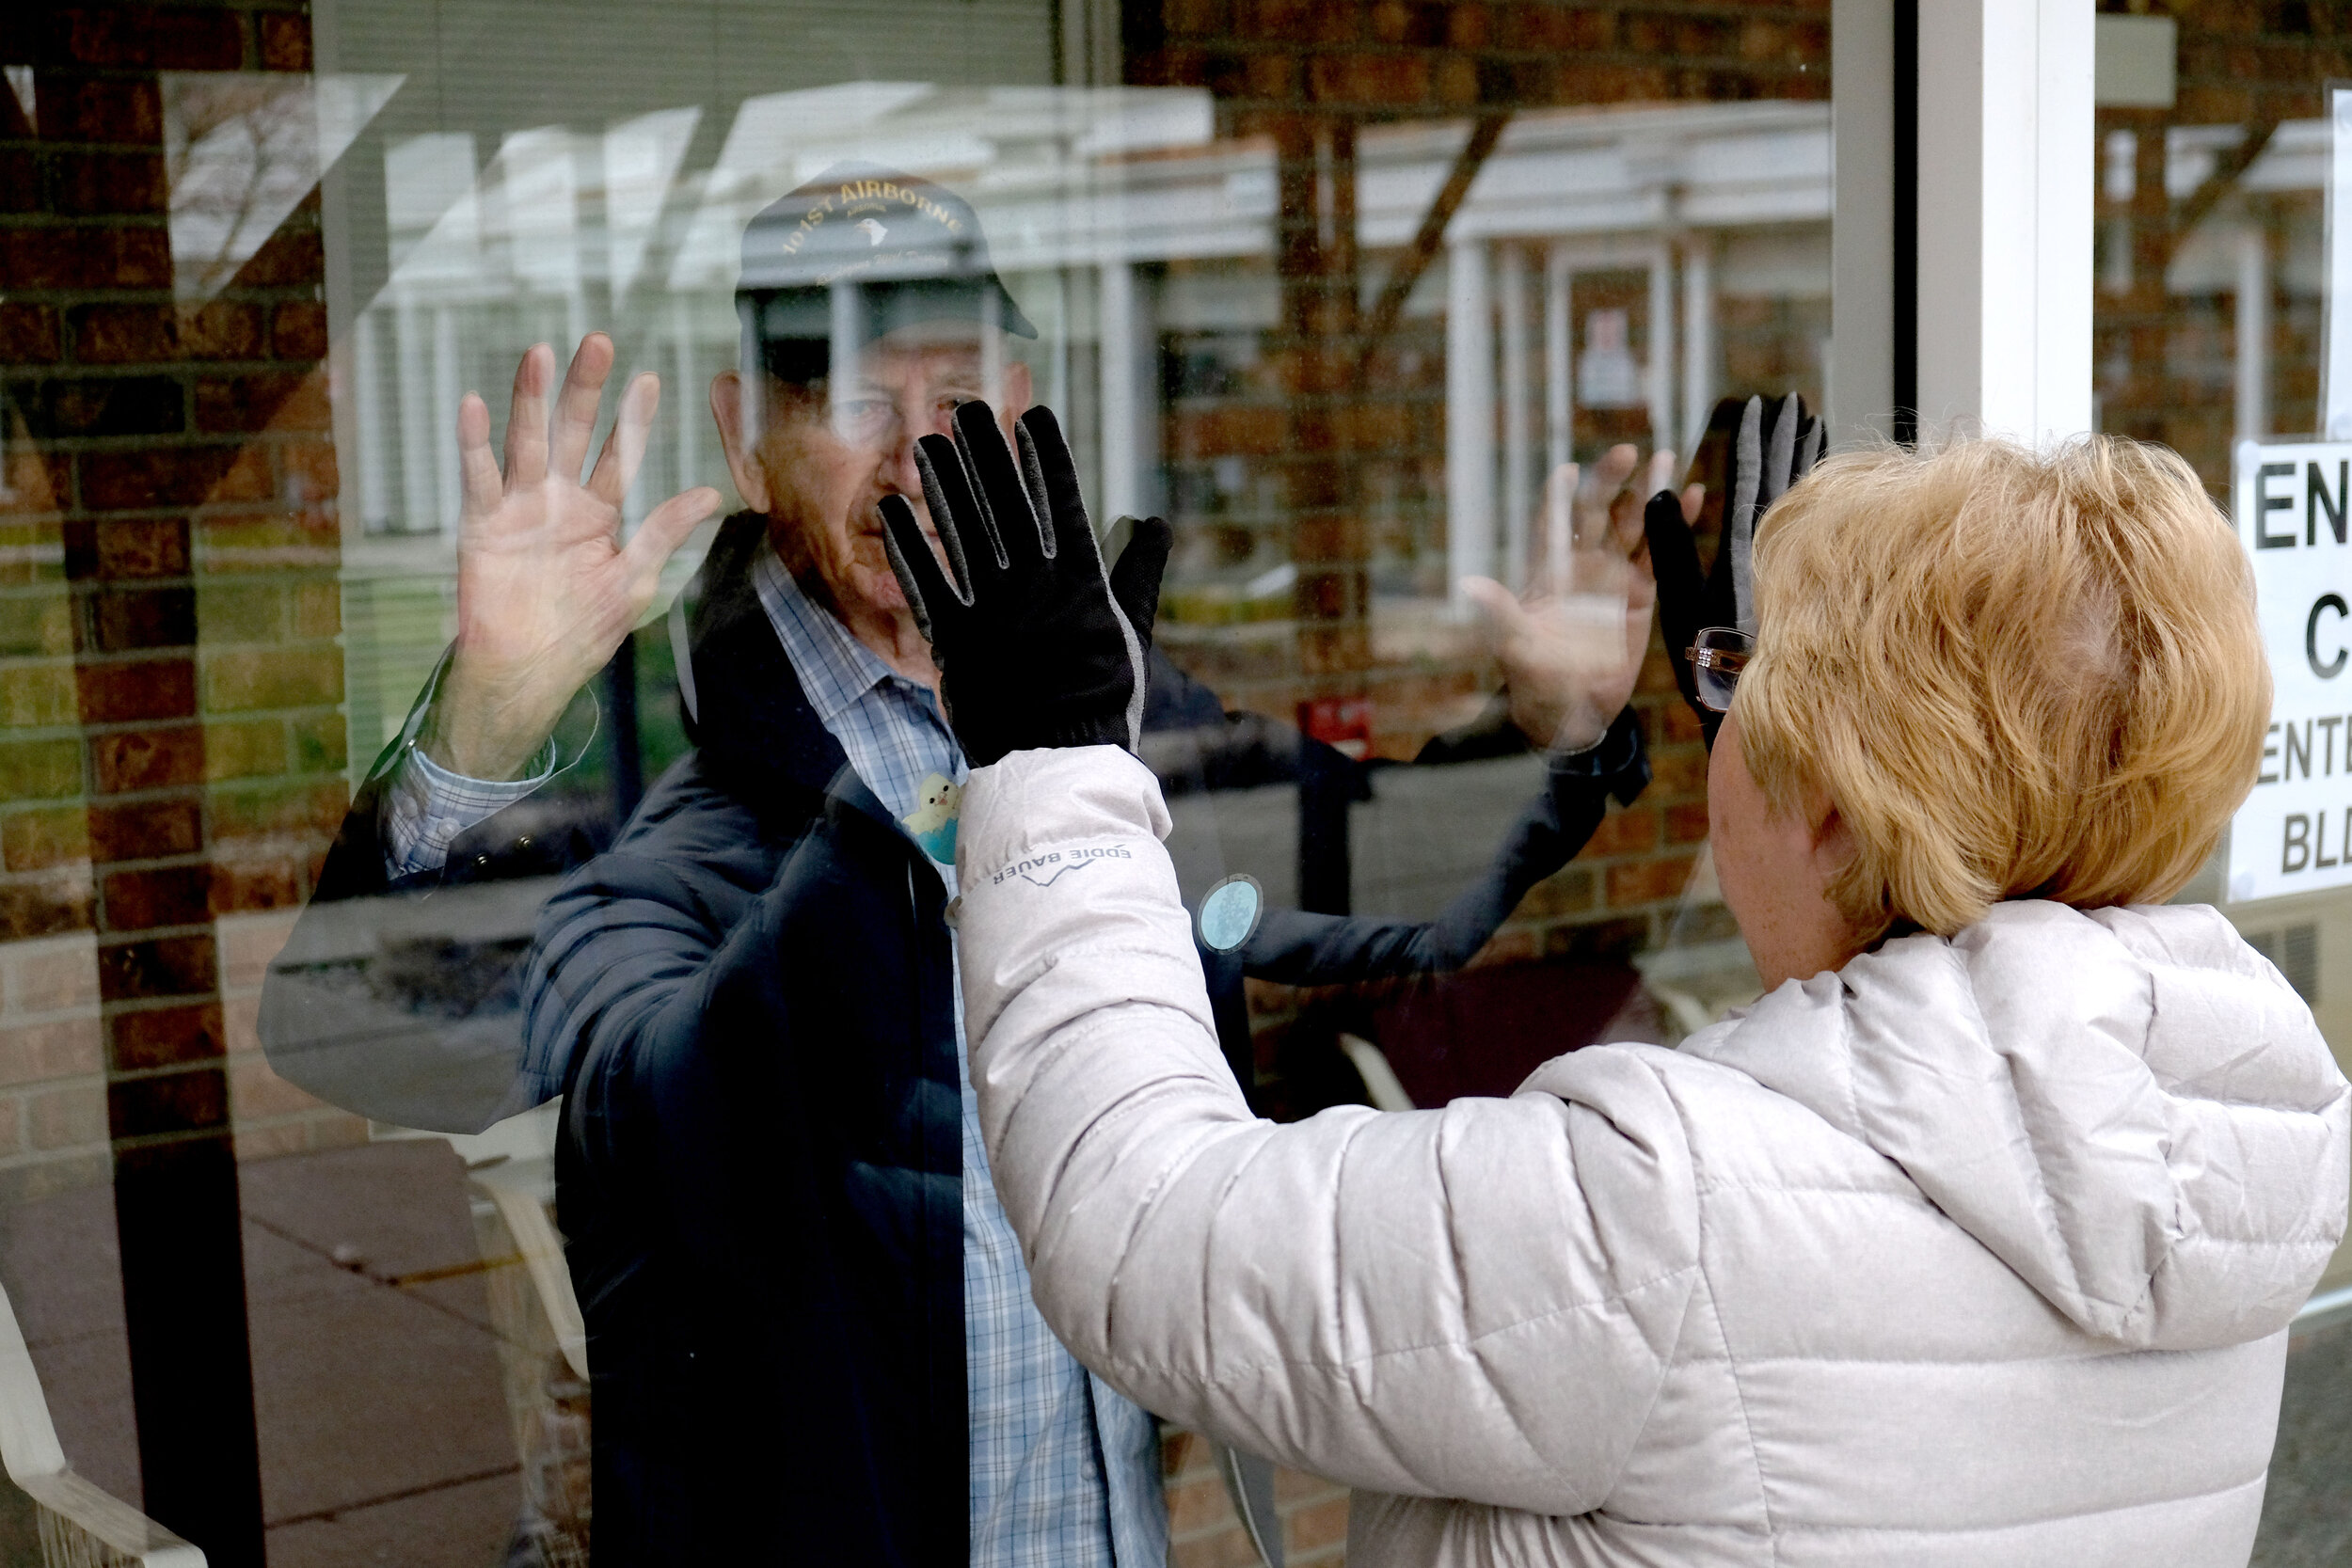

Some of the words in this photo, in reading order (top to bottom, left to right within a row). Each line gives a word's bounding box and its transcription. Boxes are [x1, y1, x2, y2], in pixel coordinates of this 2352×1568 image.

[782, 195, 834, 255] 101ST
[841, 179, 962, 233] AIRBORNE
[2307, 594, 2349, 678] C
[993, 853, 1061, 884] BAUER
[1071, 847, 1132, 860] EDDIE
